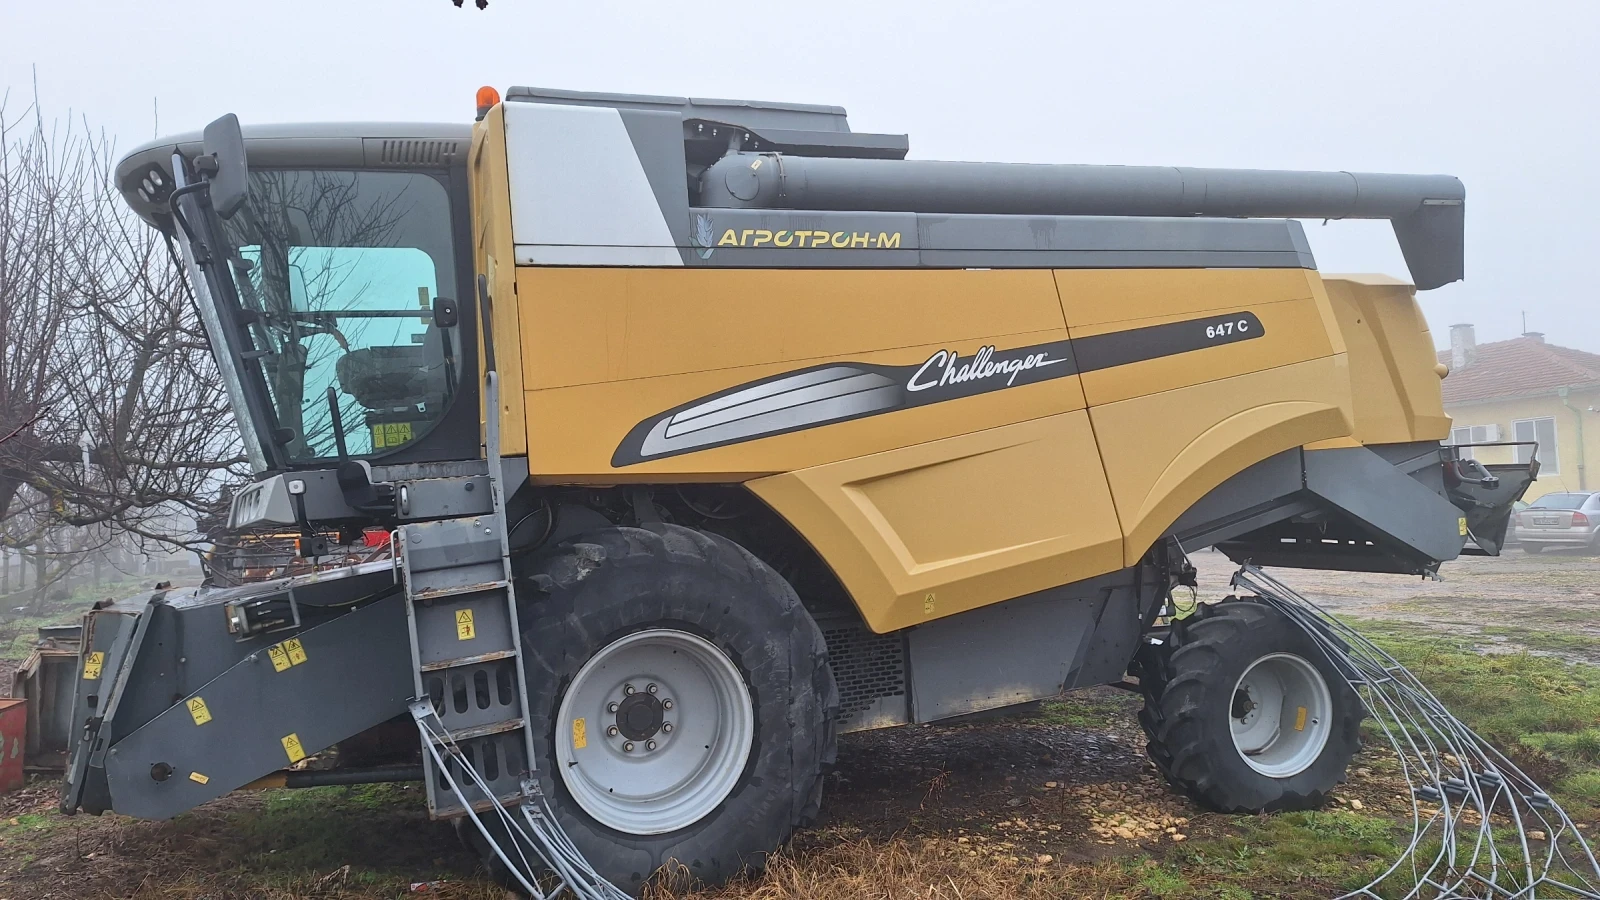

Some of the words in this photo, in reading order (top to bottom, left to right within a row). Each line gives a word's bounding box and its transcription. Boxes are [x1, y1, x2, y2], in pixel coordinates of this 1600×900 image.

[717, 228, 901, 248] АГРОТРОН-М
[1205, 322, 1234, 339] 647
[1237, 319, 1248, 332] C
[906, 345, 1067, 392] Challenger
